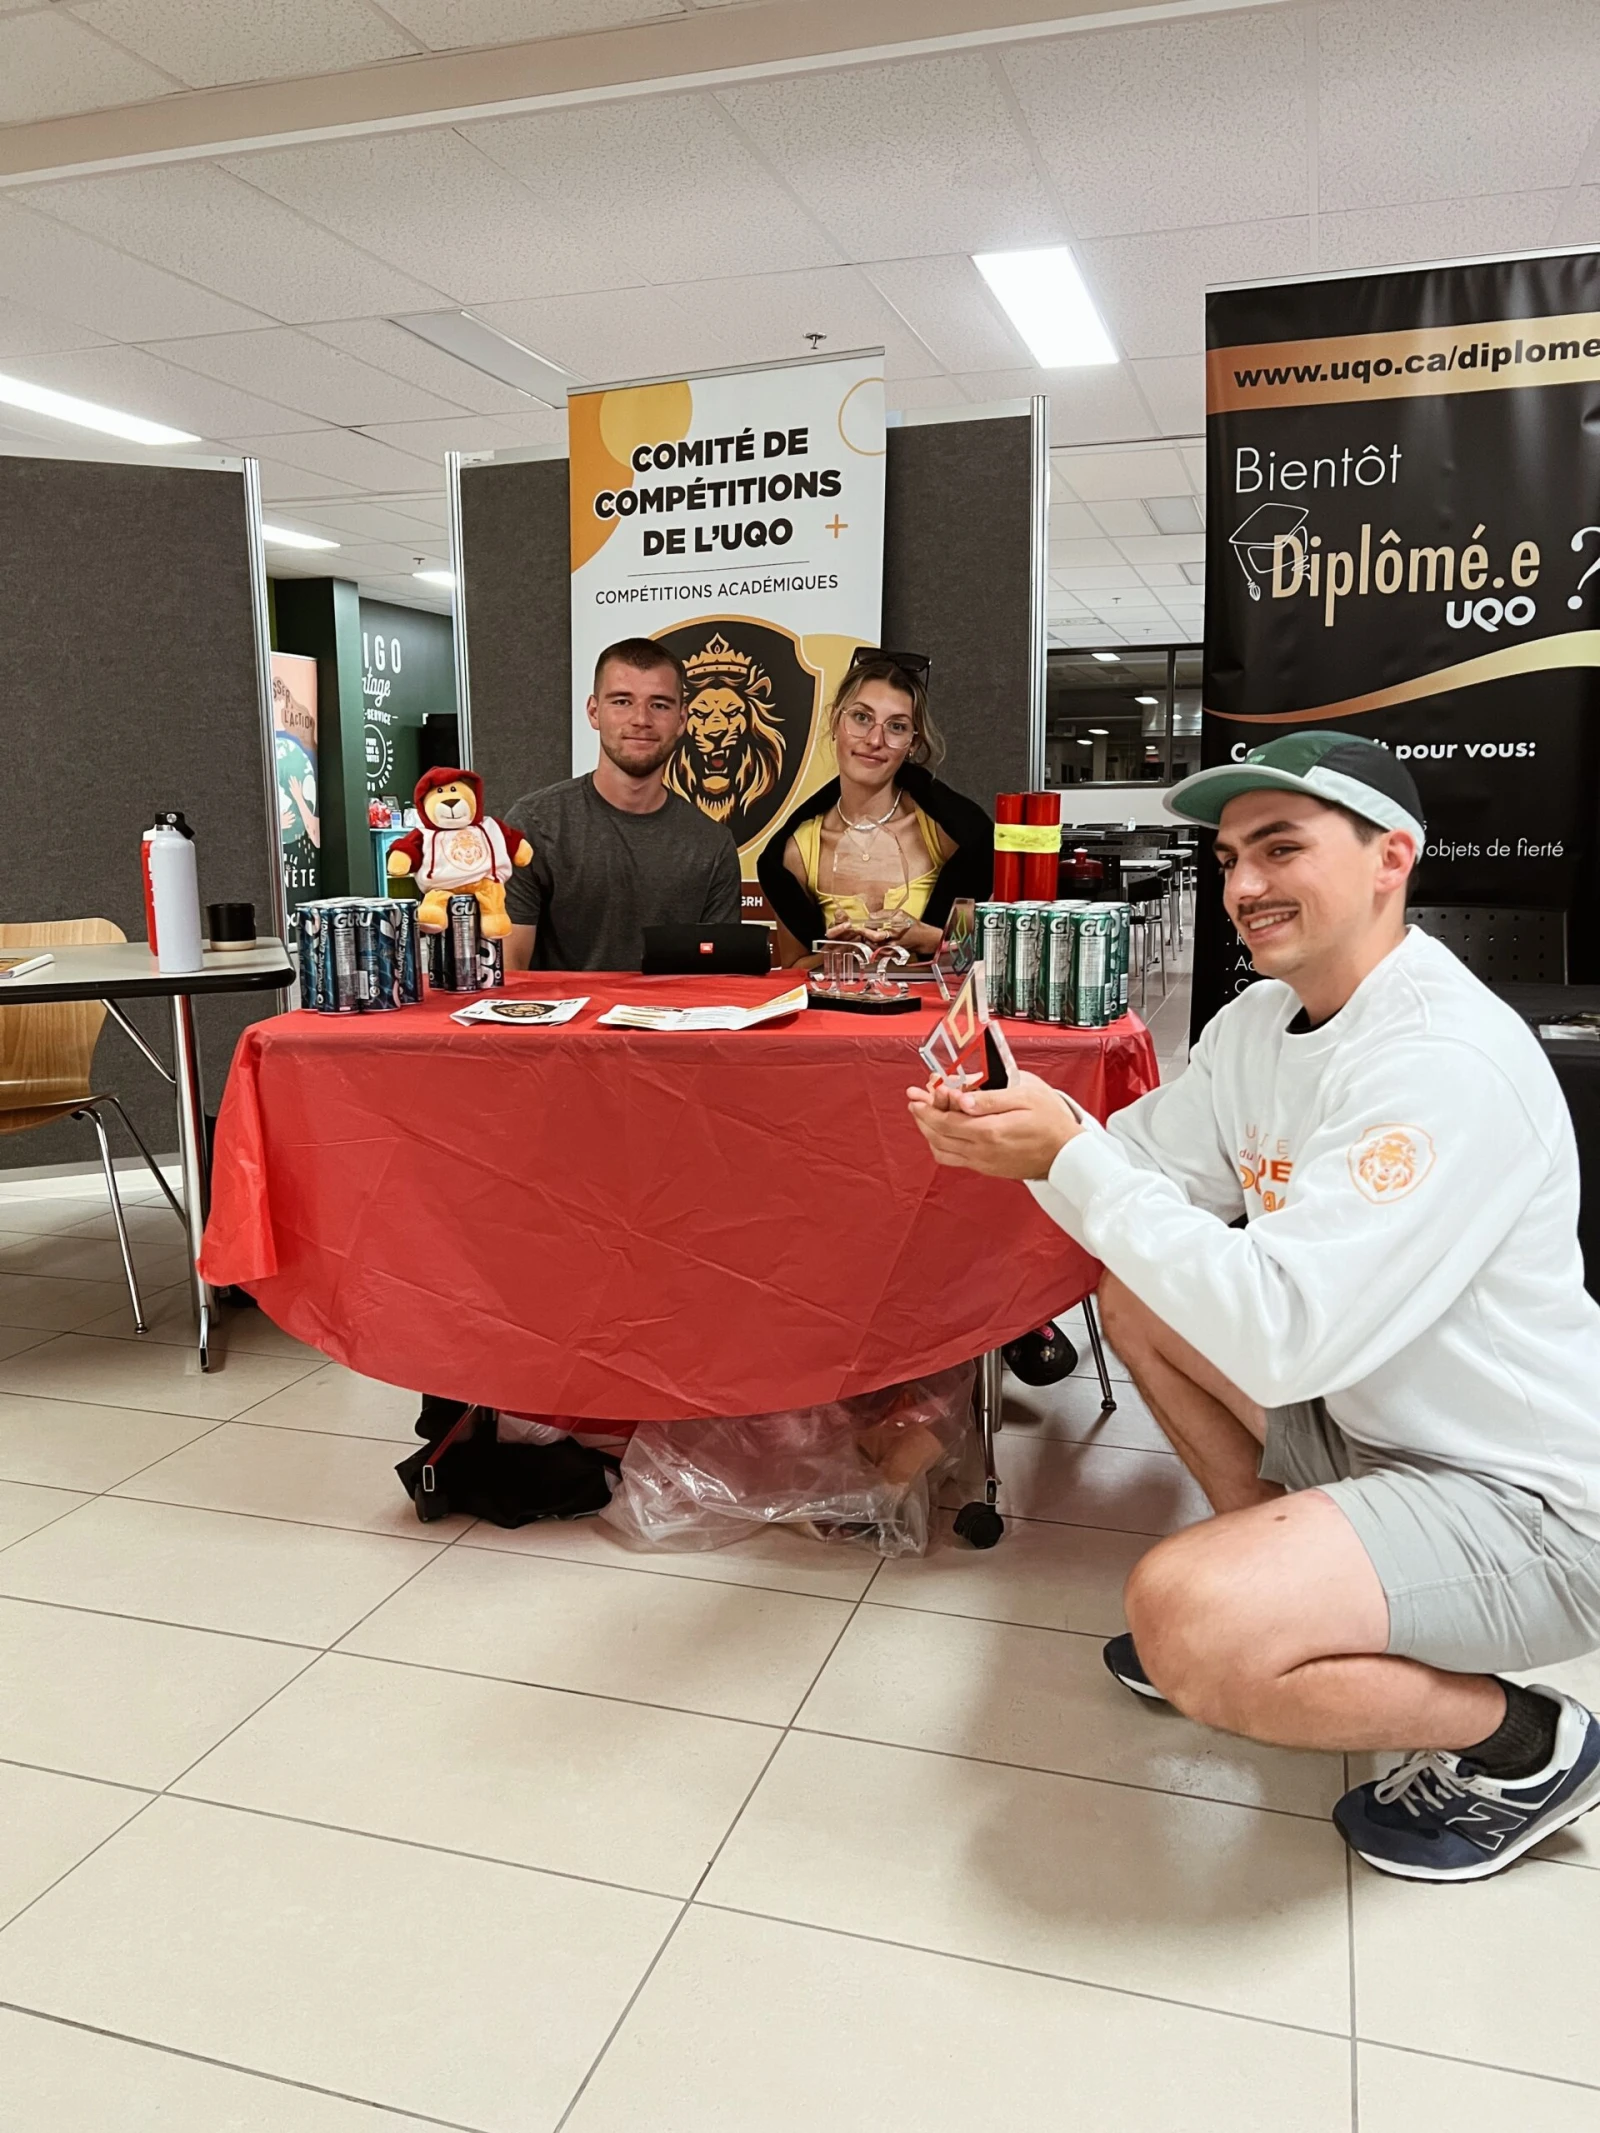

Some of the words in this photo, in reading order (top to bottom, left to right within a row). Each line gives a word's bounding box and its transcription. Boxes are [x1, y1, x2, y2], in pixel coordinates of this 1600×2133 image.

[632, 427, 755, 473] COMITÉ
[763, 427, 809, 459] DE
[1235, 444, 1402, 493] Bientôt
[594, 469, 842, 519] COMPÉTITIONS
[643, 528, 687, 557] DE
[694, 518, 793, 554] L'UQO
[595, 584, 713, 605] COMPÉTITIONS
[717, 574, 839, 599] ACADÉMIQUES
[1271, 523, 1541, 627] Diplômé.e
[1446, 596, 1537, 633] UQO
[362, 632, 402, 674] IGO
[1395, 742, 1458, 761] pour
[1465, 741, 1537, 758] vous:
[1486, 838, 1511, 857] de
[1517, 837, 1564, 857] fierté
[284, 865, 316, 888] NÈTE
[319, 917, 329, 953] ENERGY
